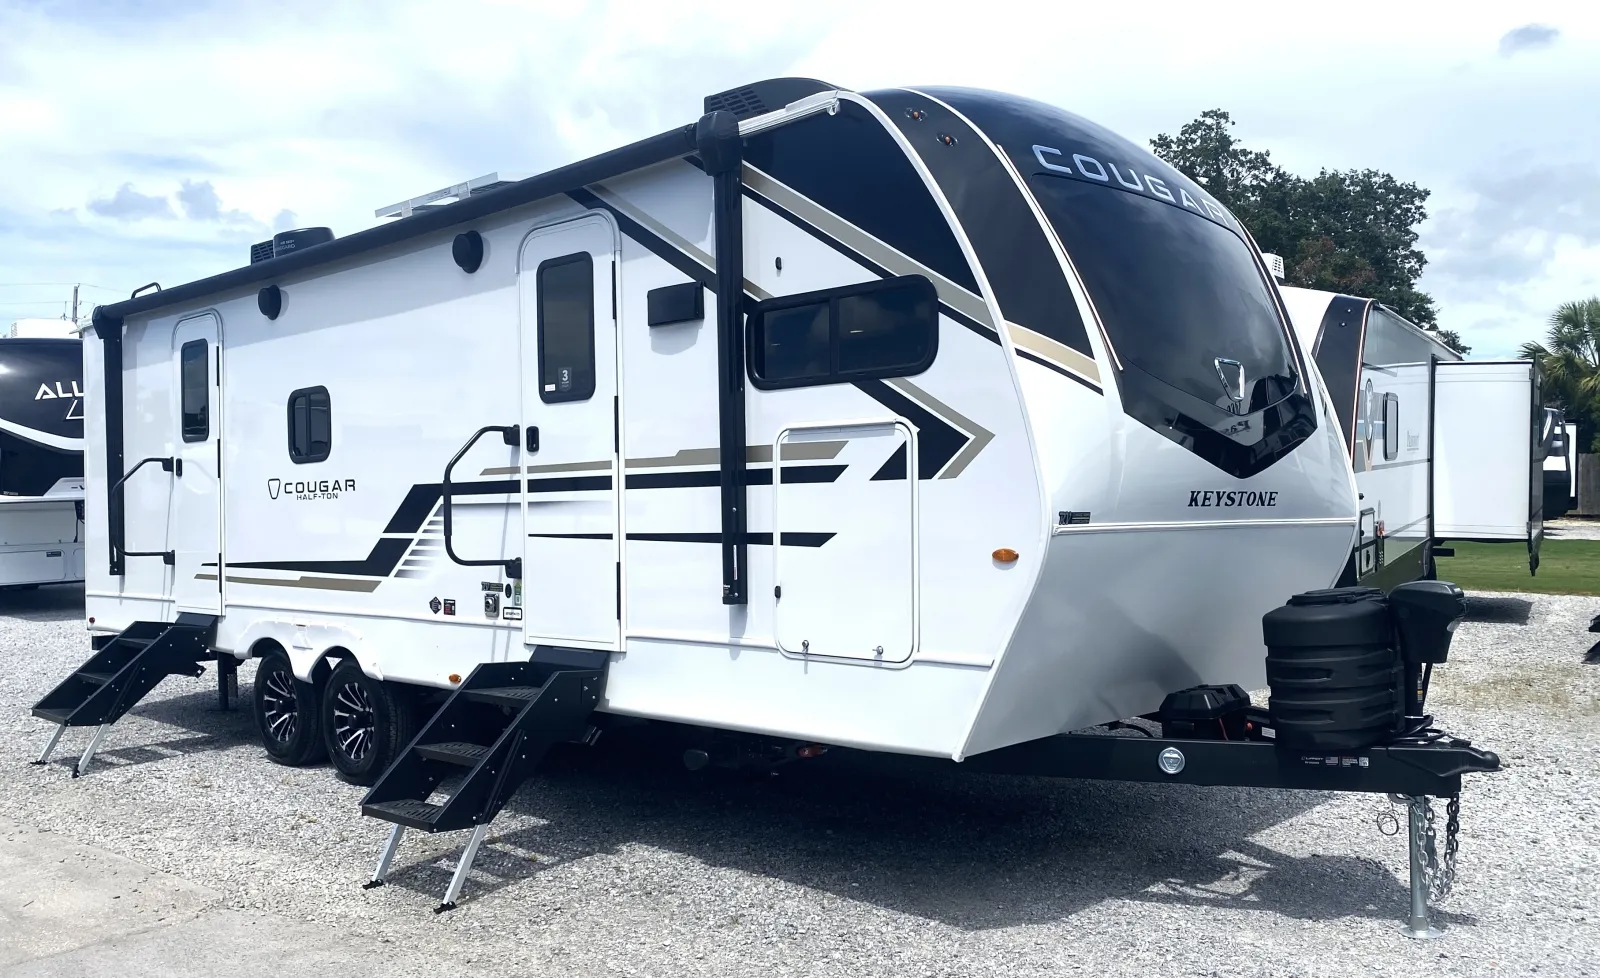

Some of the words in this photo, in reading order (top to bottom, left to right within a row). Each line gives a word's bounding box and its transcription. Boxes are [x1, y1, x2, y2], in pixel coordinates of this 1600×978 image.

[1032, 144, 1229, 226] COUGAR
[562, 369, 569, 381] 3
[284, 479, 355, 494] COUGAR
[296, 493, 339, 501] HALF-TON
[1187, 490, 1279, 507] KEYSTONE
